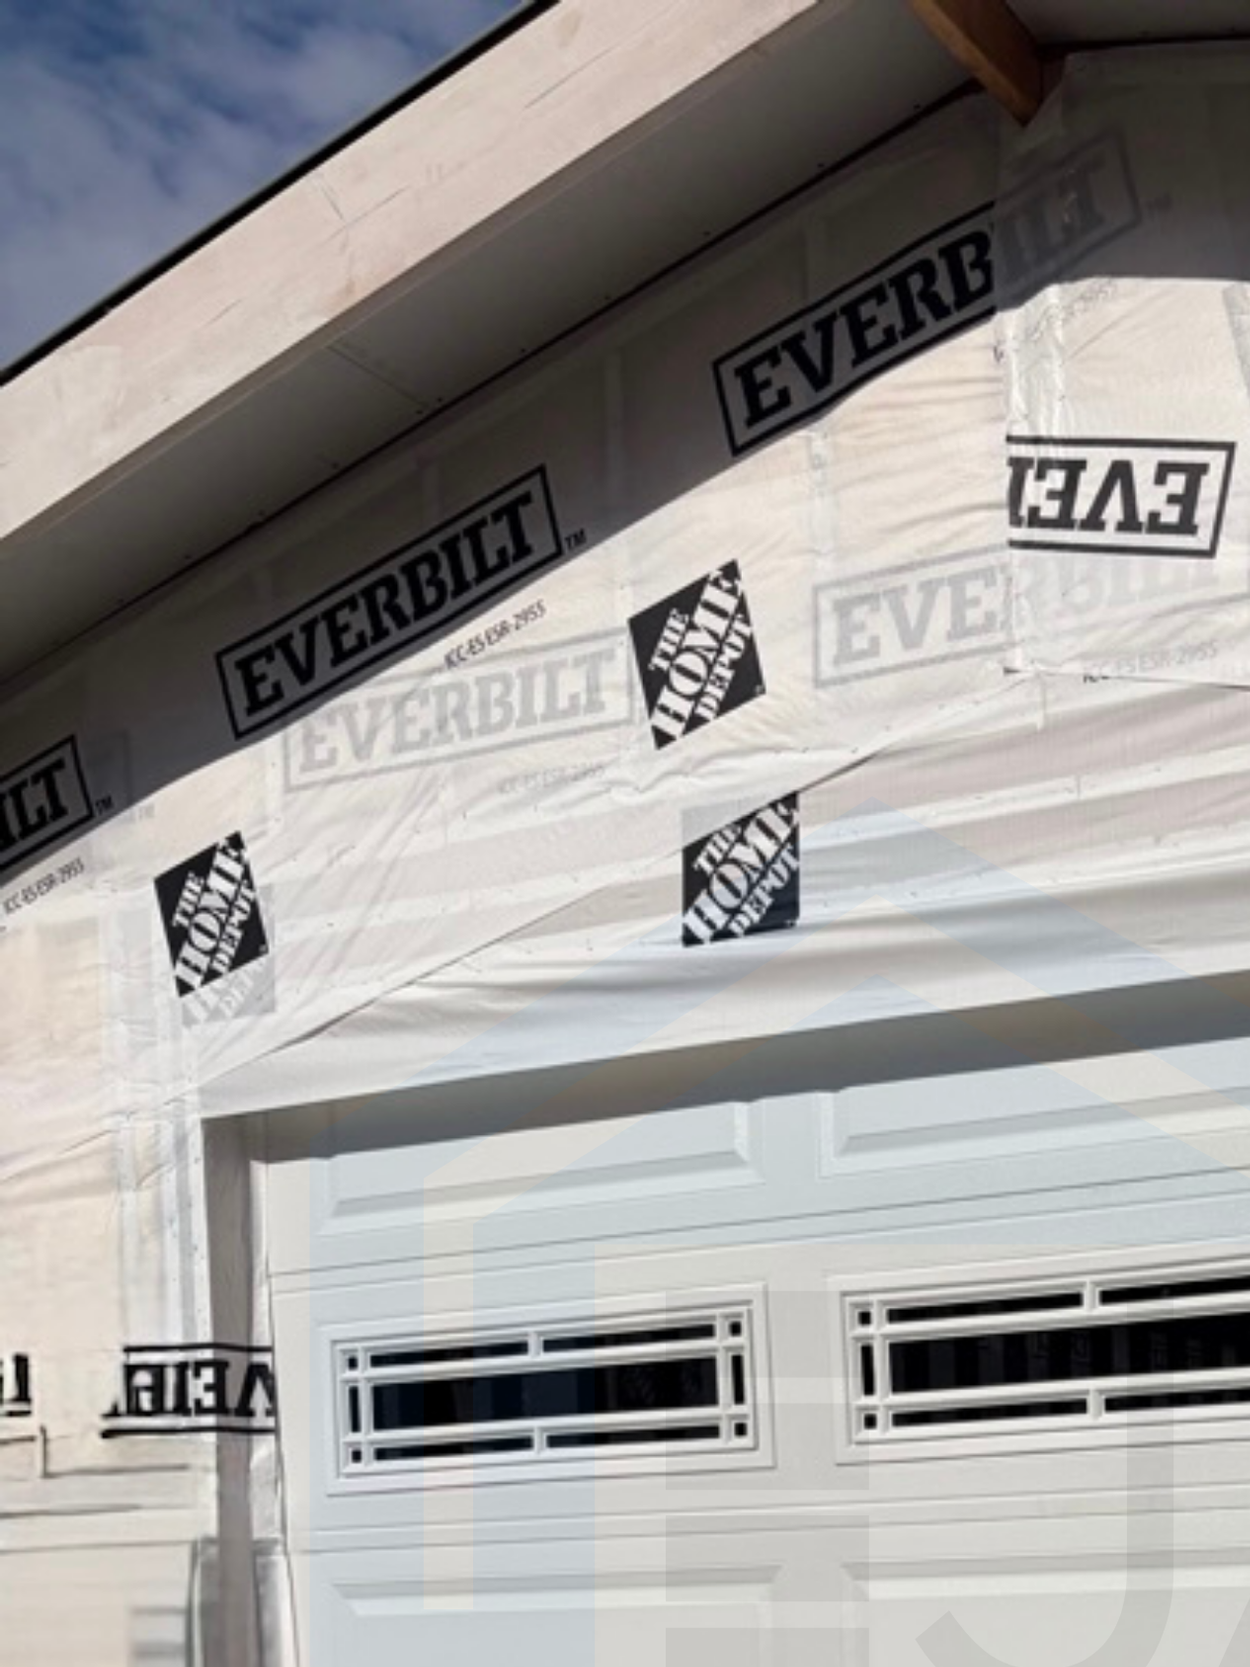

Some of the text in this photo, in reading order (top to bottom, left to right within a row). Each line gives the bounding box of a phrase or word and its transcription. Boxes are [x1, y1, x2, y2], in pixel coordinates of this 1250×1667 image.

[235, 491, 533, 716] EVERBILT
[648, 607, 690, 671] THE
[651, 569, 741, 738] HOME
[694, 614, 752, 721] DEPOT
[172, 872, 205, 928] THE
[682, 802, 799, 944] HOME
[693, 822, 743, 879] THE
[728, 844, 799, 938] DEPOT
[174, 838, 248, 991] HOME
[209, 878, 256, 976] DEPOT
